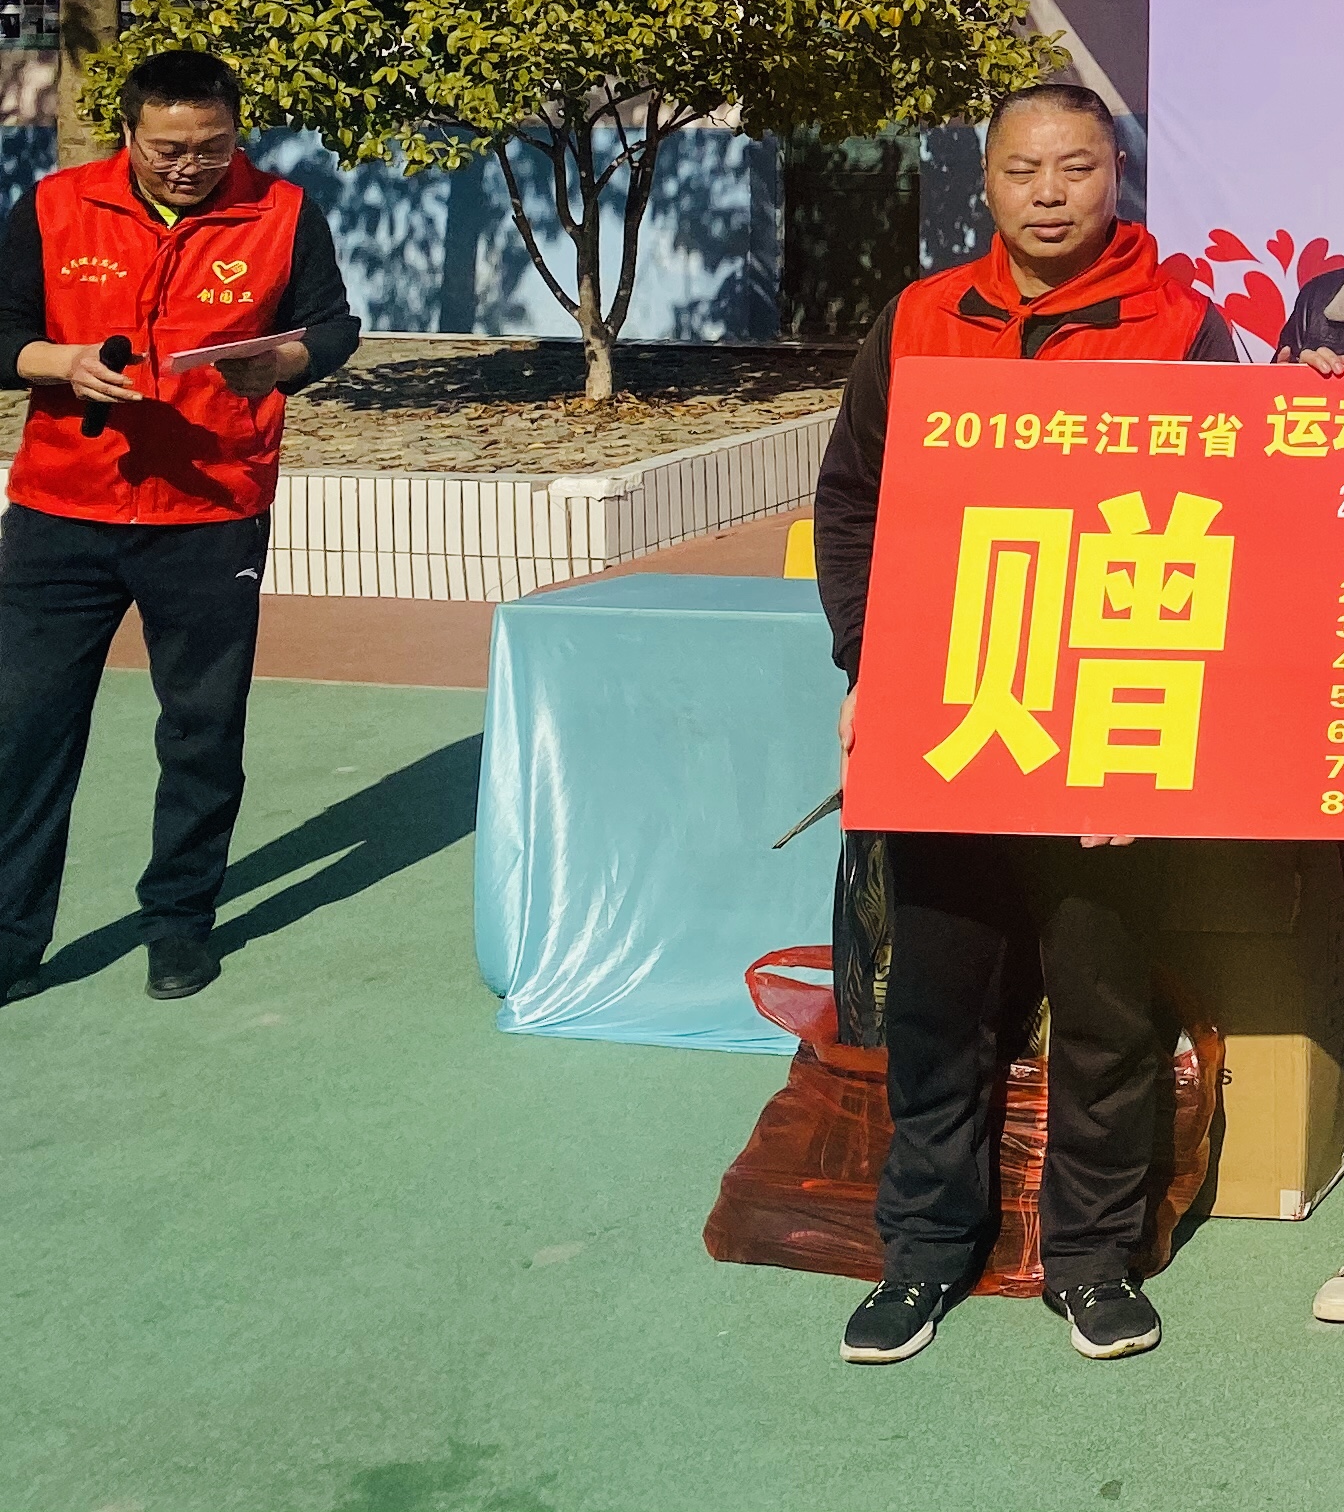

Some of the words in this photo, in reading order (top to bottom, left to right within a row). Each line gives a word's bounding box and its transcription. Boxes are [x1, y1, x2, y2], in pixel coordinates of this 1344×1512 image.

[924, 410, 1243, 457] 2019年江西省
[923, 491, 1234, 790] 赠
